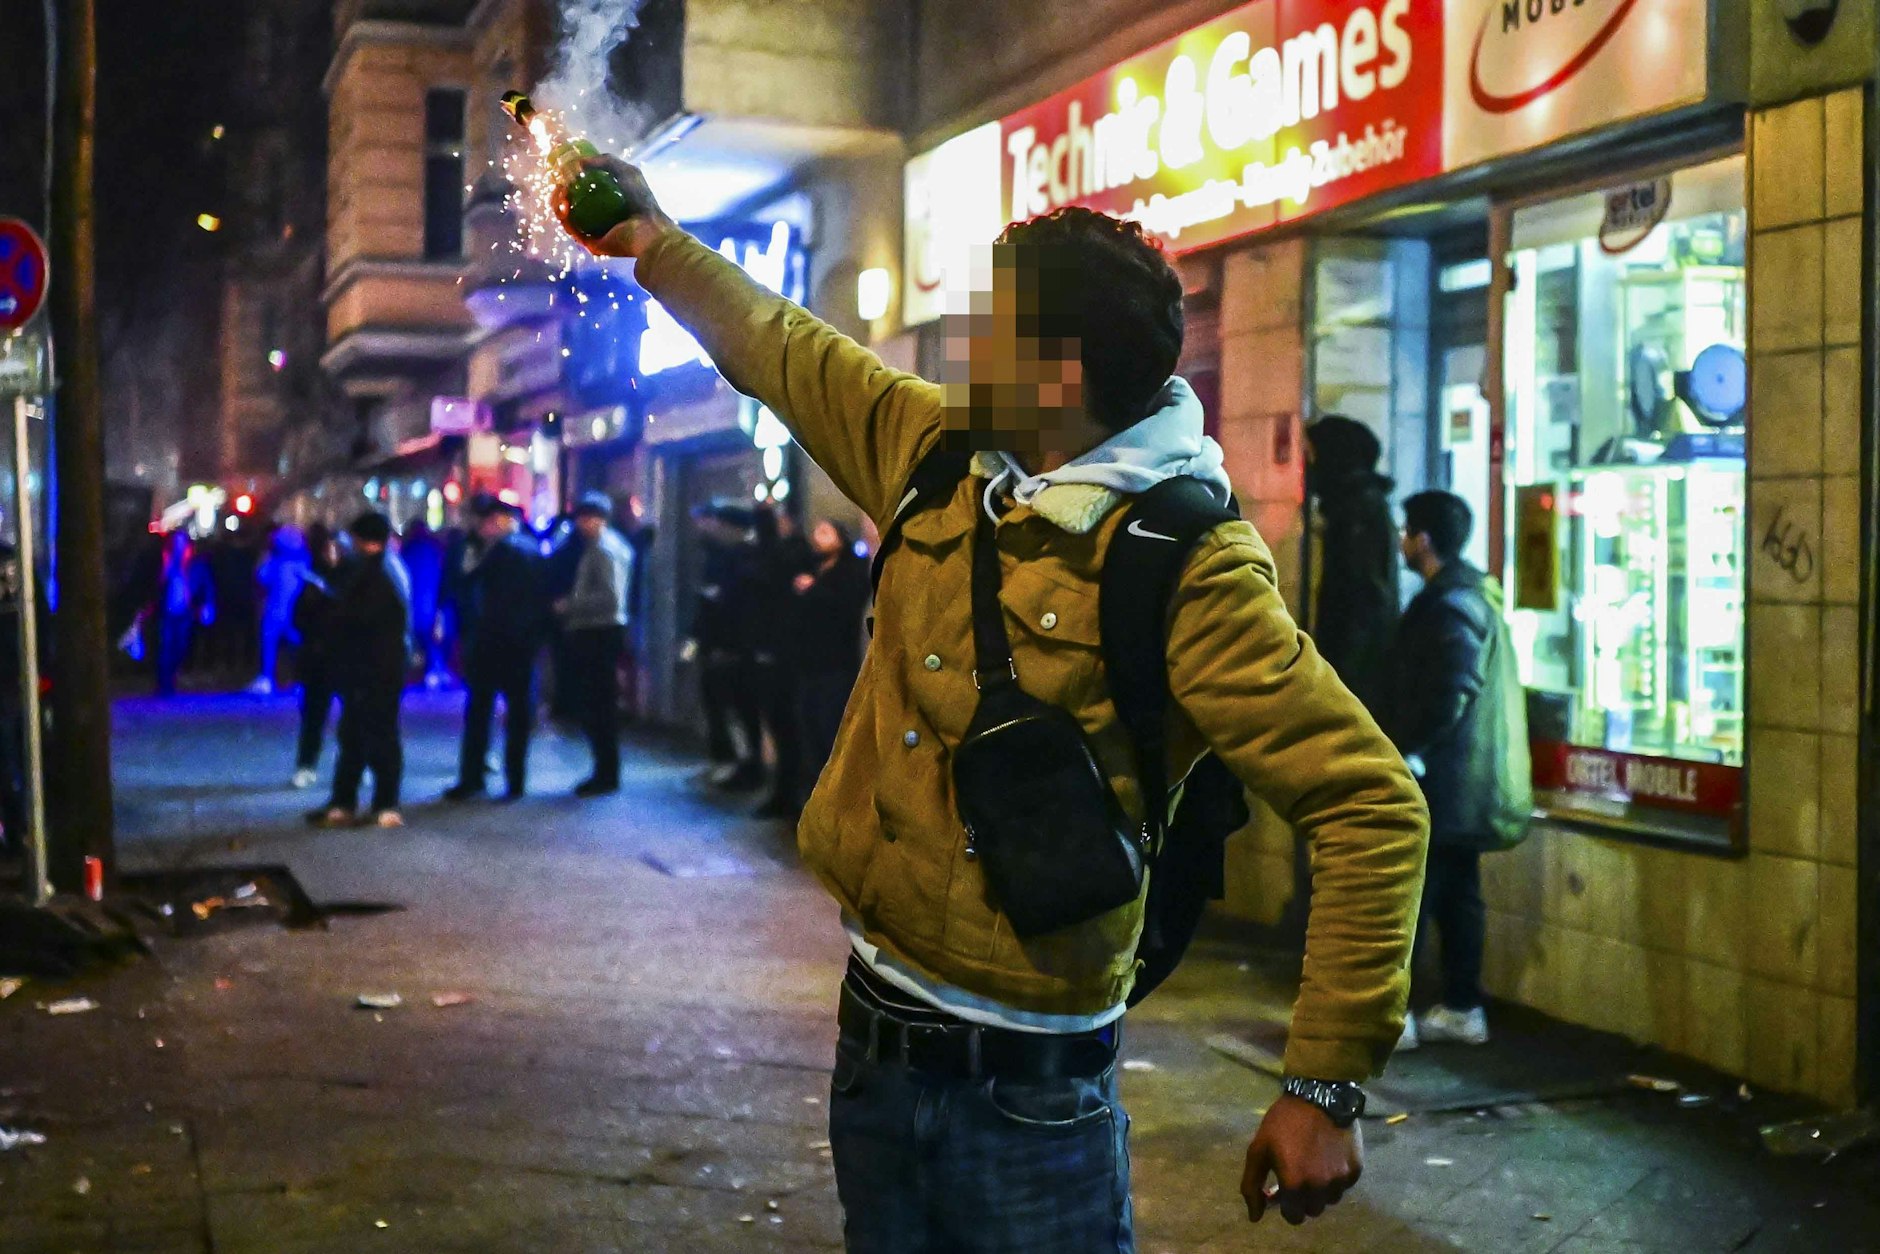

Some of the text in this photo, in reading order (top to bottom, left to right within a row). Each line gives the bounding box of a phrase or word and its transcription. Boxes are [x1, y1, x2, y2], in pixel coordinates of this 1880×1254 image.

[1008, 77, 1160, 222] Technic
[1160, 54, 1204, 170] &
[1206, 0, 1412, 150] Games
